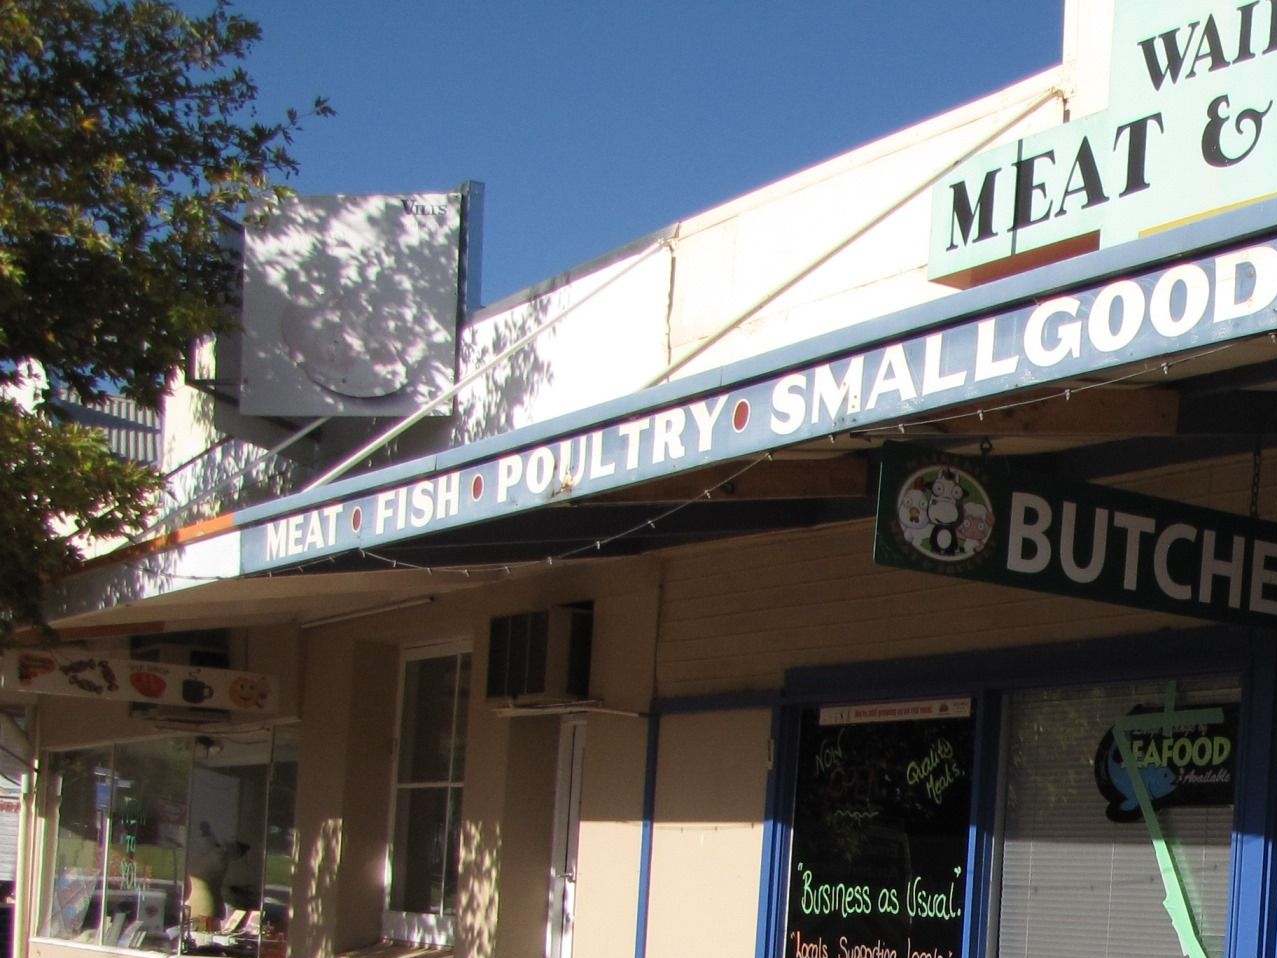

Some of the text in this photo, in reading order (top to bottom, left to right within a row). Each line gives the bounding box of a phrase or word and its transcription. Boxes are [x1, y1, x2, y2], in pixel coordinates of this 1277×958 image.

[945, 112, 1165, 253] MEAT
[1200, 94, 1274, 169] &
[264, 504, 344, 562] MEAT
[374, 472, 461, 537] FISH
[497, 394, 732, 504] POULTRY
[906, 737, 953, 785] Quality
[1122, 736, 1231, 768] EAFOOD
[878, 888, 900, 915] as
